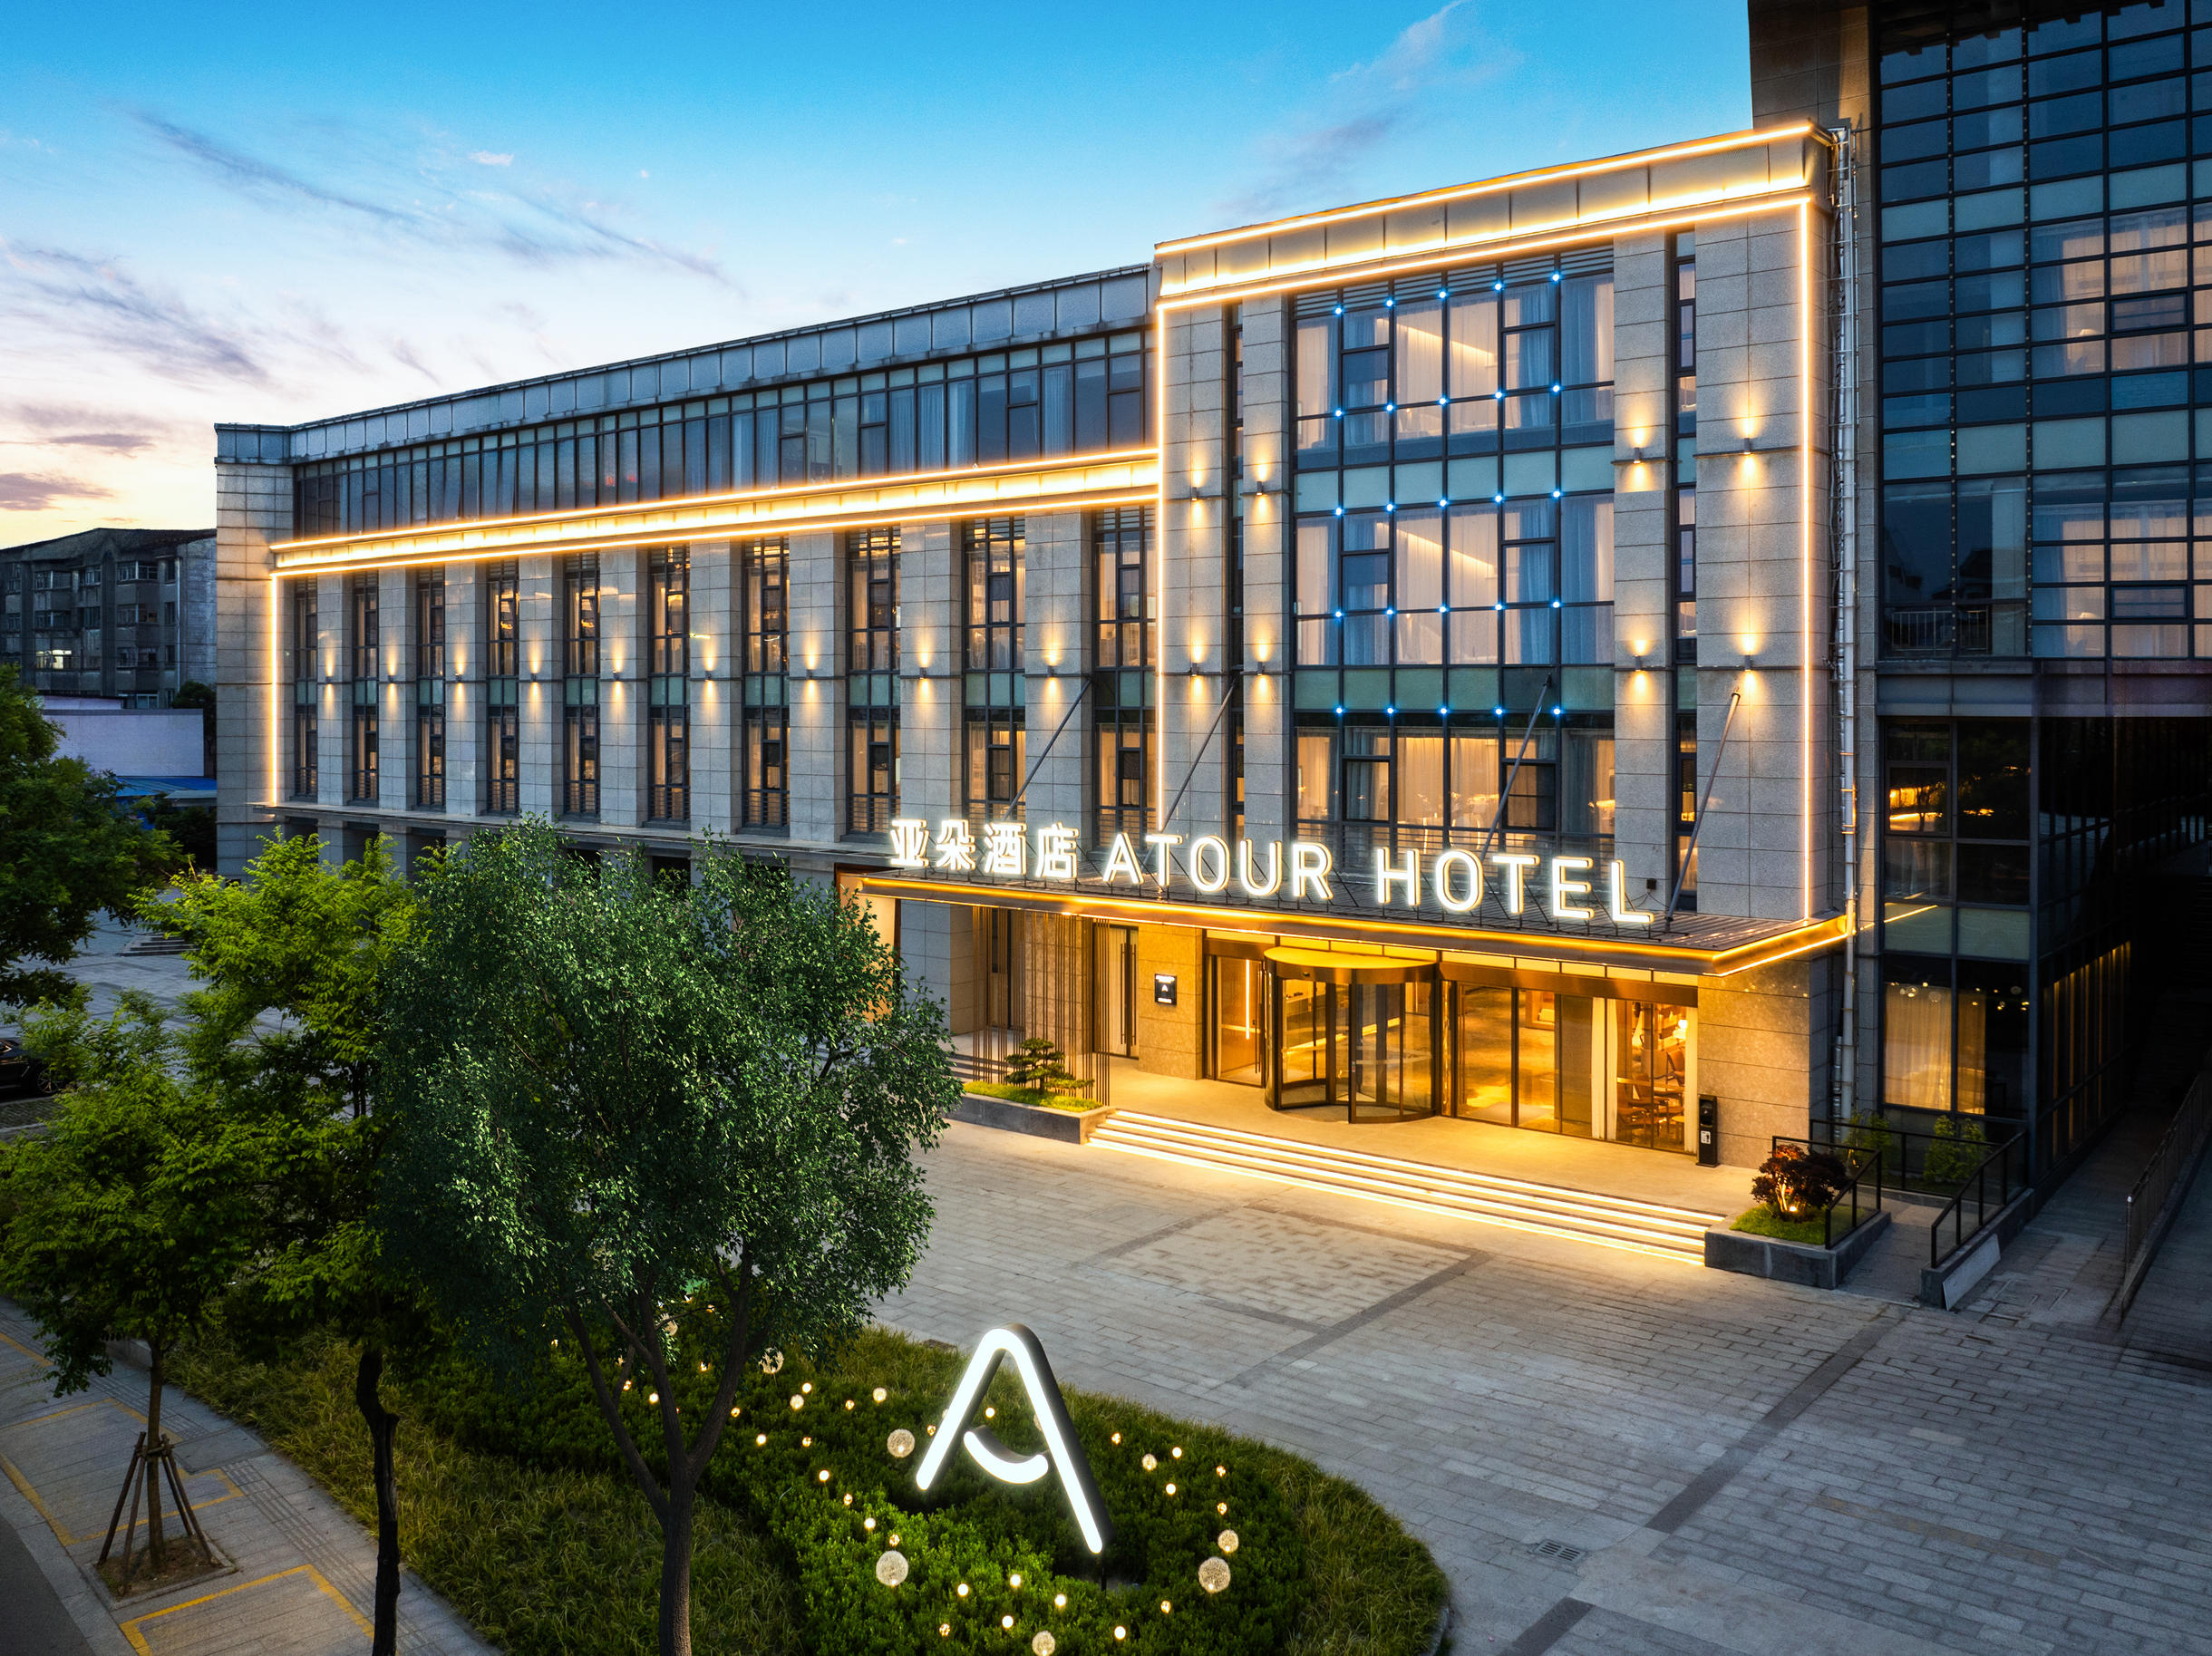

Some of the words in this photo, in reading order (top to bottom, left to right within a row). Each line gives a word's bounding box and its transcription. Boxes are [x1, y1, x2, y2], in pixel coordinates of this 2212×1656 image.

[890, 818, 1079, 878] 亚朵酒店
[1102, 832, 1334, 900] ATOUR
[1376, 847, 1655, 925] HOTEL
